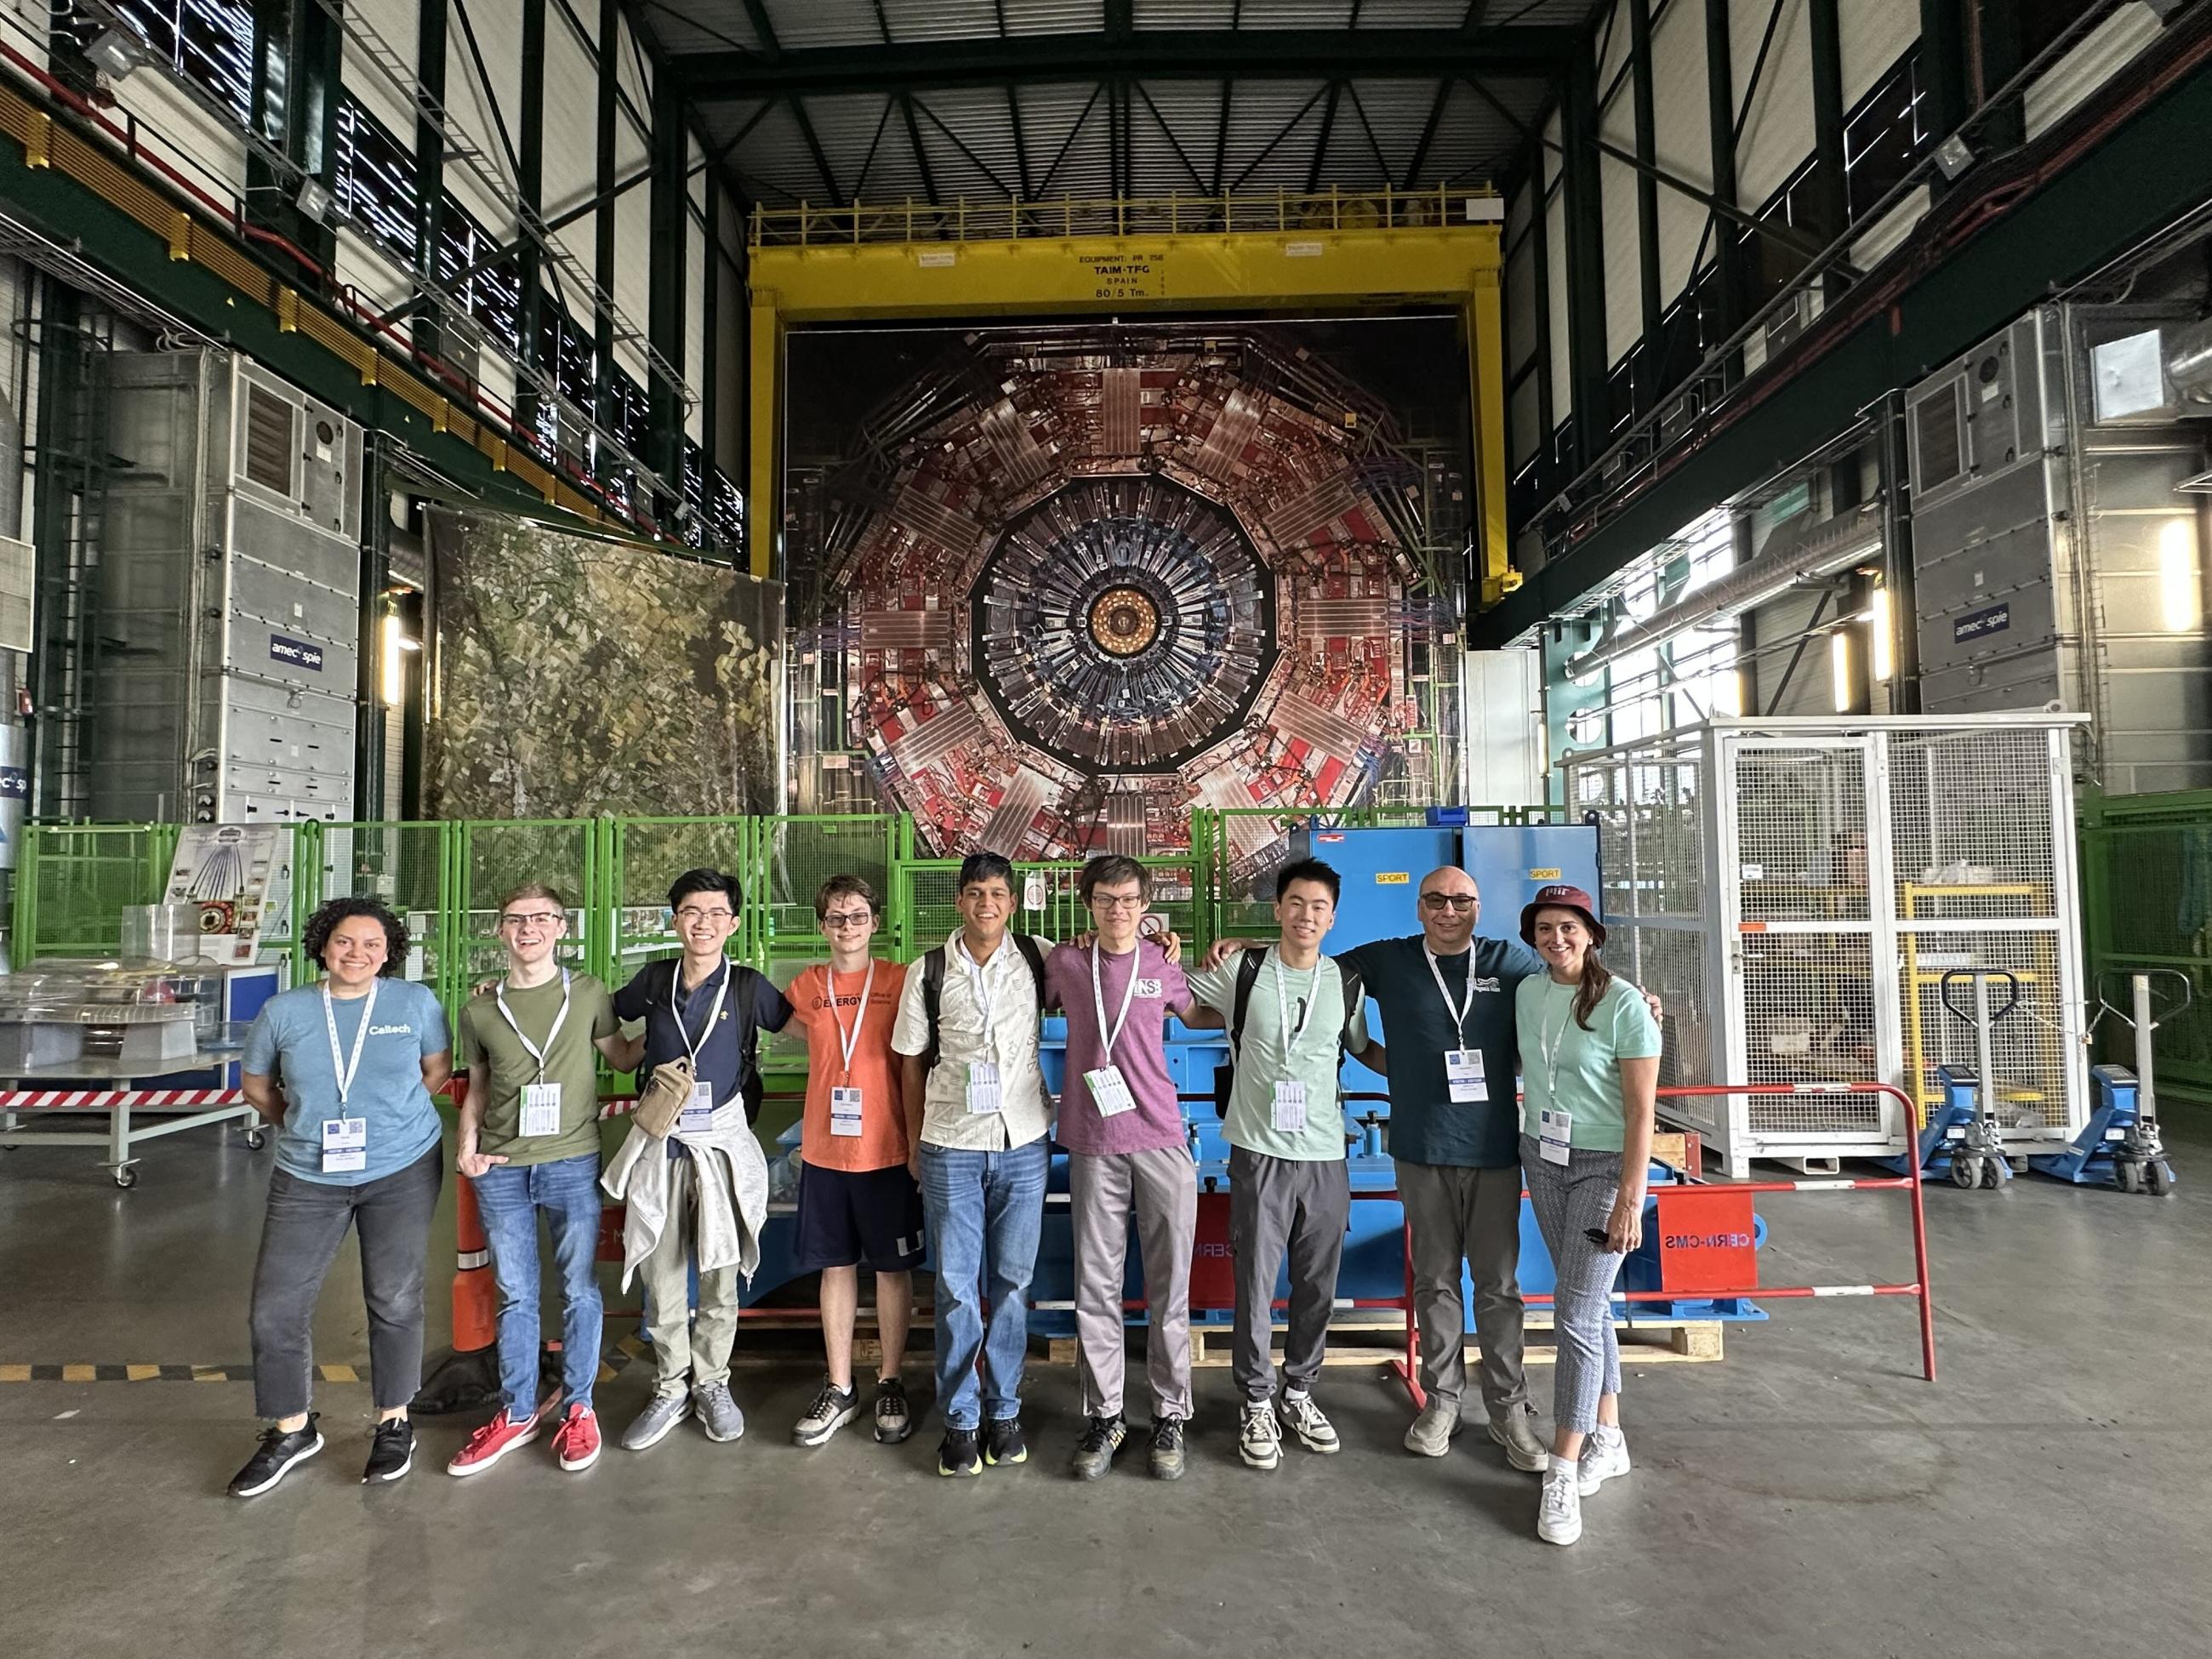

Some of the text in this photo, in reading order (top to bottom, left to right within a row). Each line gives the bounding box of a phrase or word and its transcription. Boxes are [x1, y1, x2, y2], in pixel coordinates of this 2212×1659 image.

[1956, 611, 2008, 636] amec spie
[272, 643, 322, 664] amec spie
[1377, 874, 1407, 882] SPORT
[1530, 869, 1559, 878] SPORT
[369, 1023, 411, 1035] Caltech
